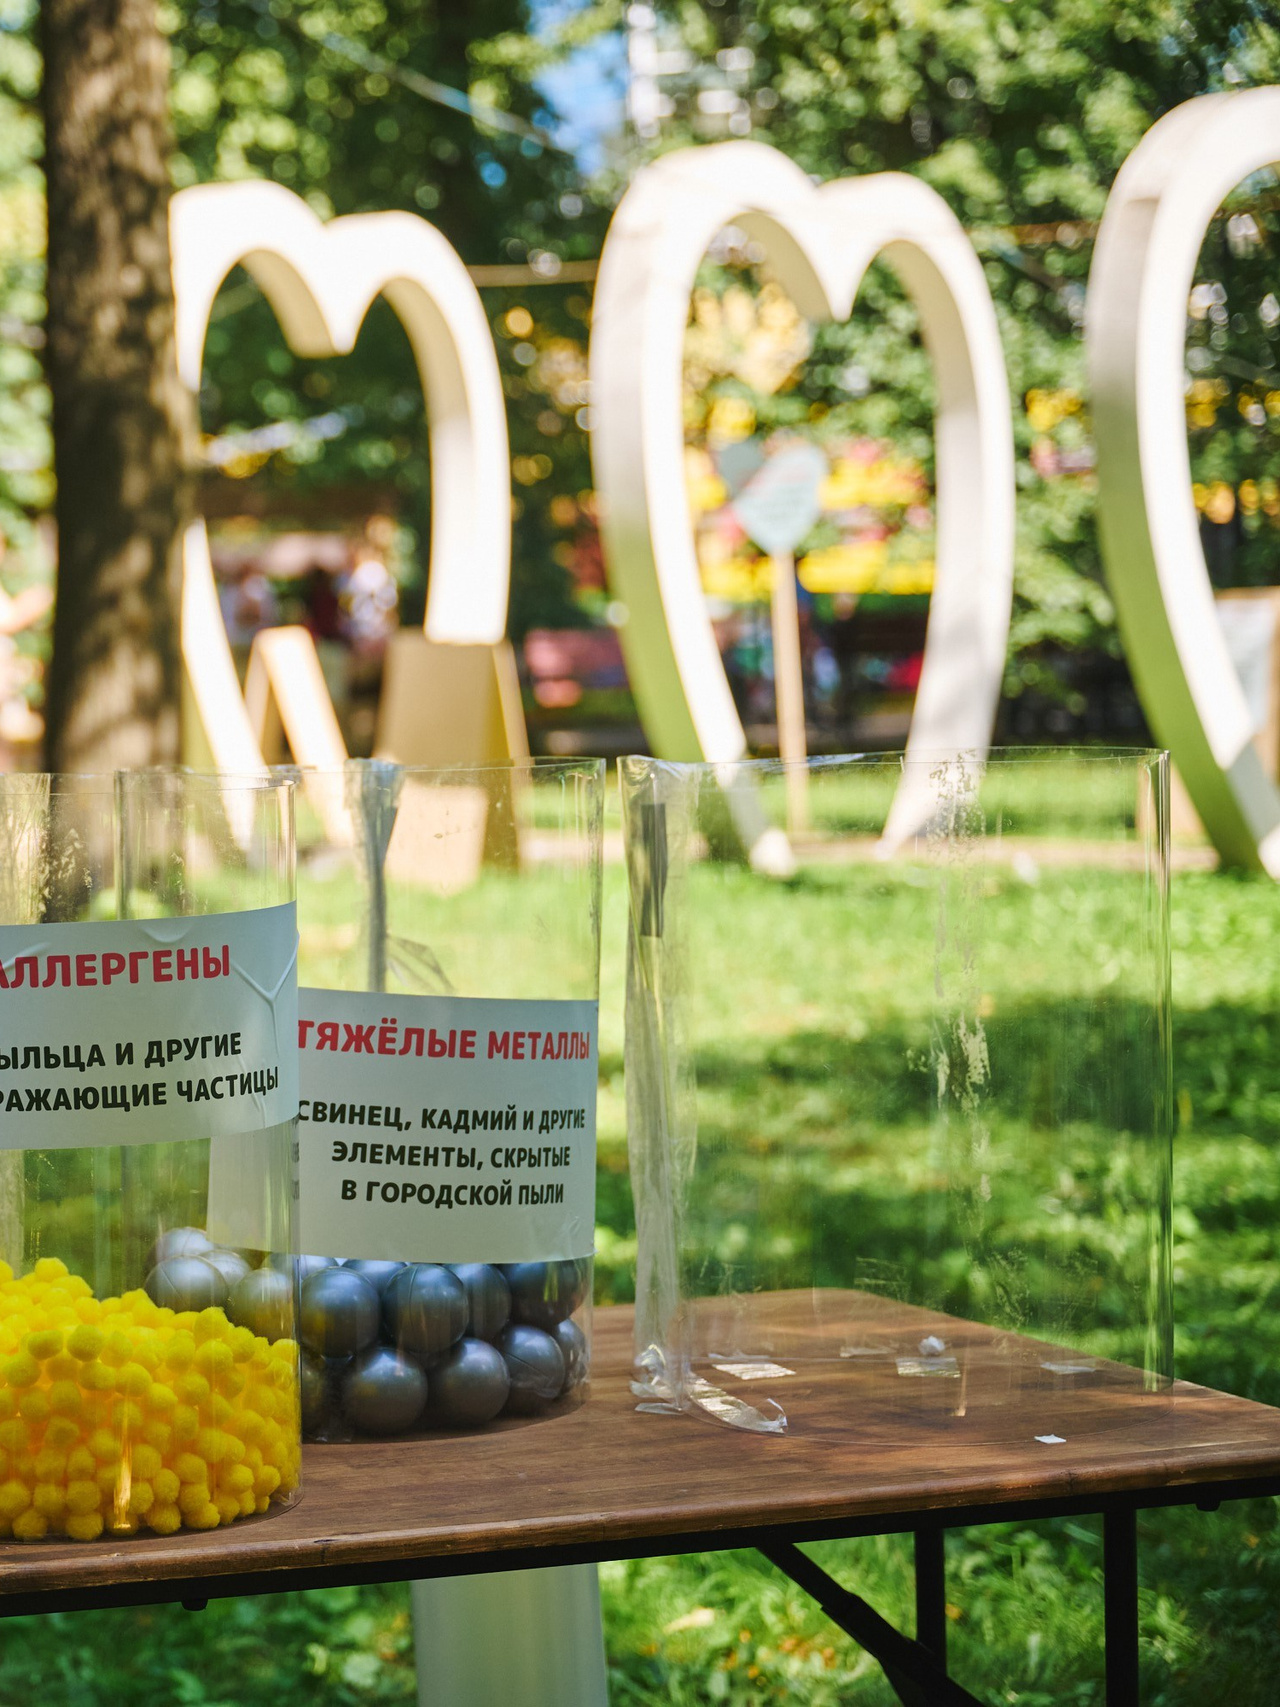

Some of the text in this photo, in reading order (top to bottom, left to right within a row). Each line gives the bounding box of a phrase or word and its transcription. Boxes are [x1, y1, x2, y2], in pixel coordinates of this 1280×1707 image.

[115, 1042, 134, 1065] И
[144, 1032, 241, 1069] ДРУГИЕ
[298, 1017, 590, 1061] ТЯЖЁЛЫЕ МЕТАЛЛЫ
[176, 1066, 279, 1103] ЧАСТИЦЫ
[298, 1100, 586, 1134] СВИНЕЦ, КАДМИЙ И ДРУГИЕ
[332, 1141, 571, 1171] ЭЛЕМЕНТЫ, СКРЫТЫЕ
[341, 1178, 564, 1209] В ГОРОДСКОЙ ПЫЛИ
